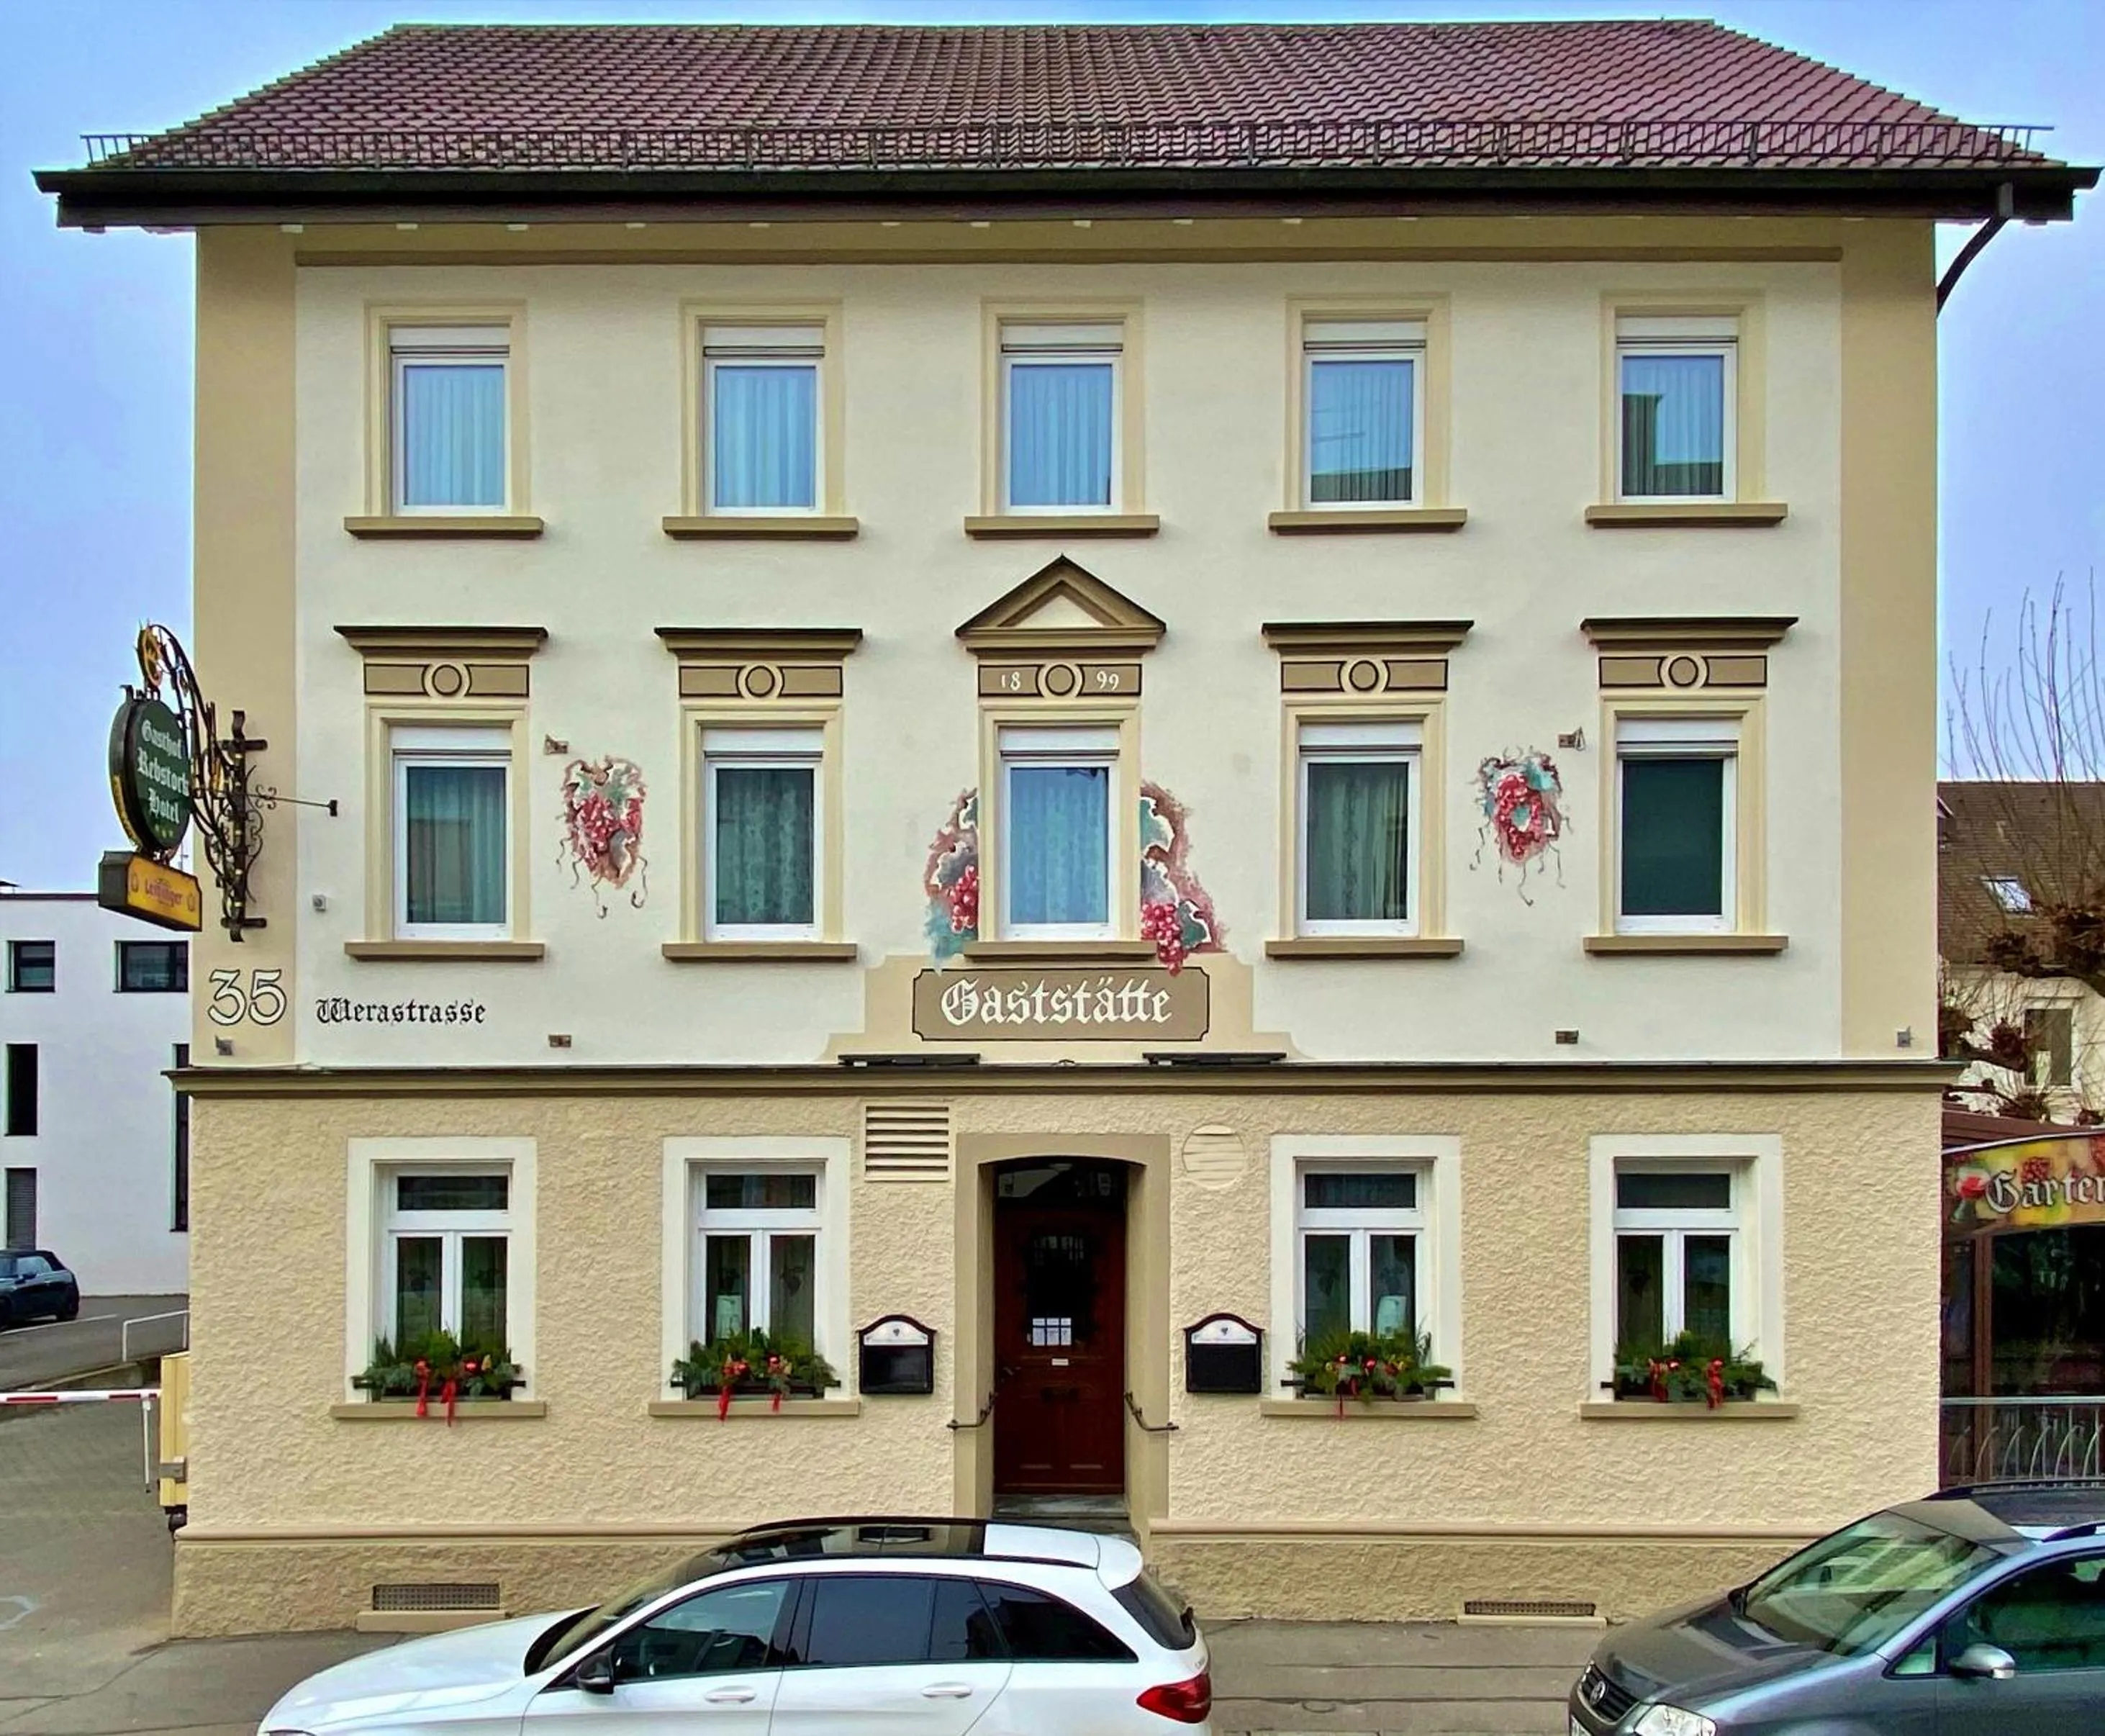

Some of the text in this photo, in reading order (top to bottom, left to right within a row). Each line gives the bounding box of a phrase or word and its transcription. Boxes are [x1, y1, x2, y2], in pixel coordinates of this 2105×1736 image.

[1001, 670, 1119, 691] 18 99
[148, 787, 180, 824] Hotel
[207, 969, 287, 1026] 35
[315, 997, 486, 1026] Werastrasse
[941, 976, 1173, 1026] Gaststätte
